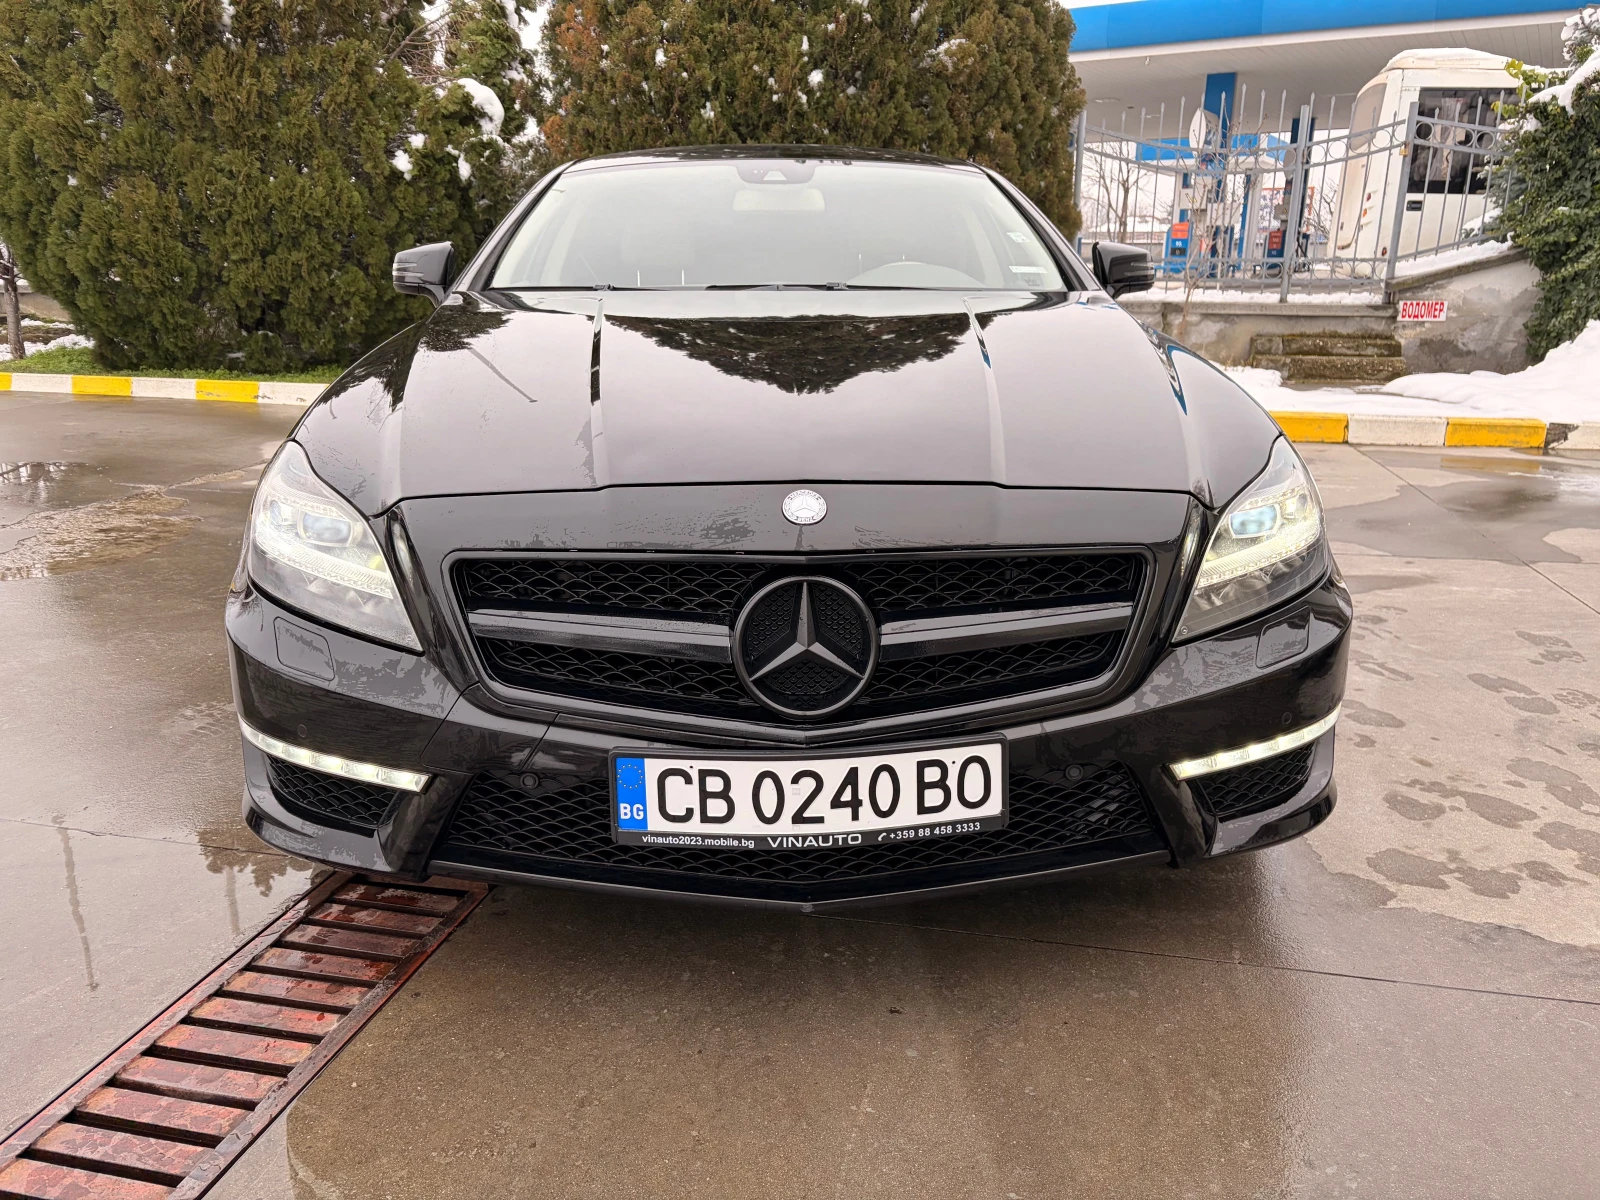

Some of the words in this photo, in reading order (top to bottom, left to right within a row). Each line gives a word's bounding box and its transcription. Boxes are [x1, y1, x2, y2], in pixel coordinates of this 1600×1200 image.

[1401, 301, 1445, 319] ВОДОМЕР
[656, 767, 736, 825] CB
[751, 763, 901, 826] 0240
[916, 755, 992, 816] BO
[619, 803, 645, 820] BG
[641, 834, 755, 849] vinauto2023.mobile.bg
[767, 833, 862, 848] VINAUTO
[889, 829, 915, 840] +359
[918, 827, 931, 837] 88
[933, 824, 953, 835] 458
[955, 821, 981, 833] 3333
